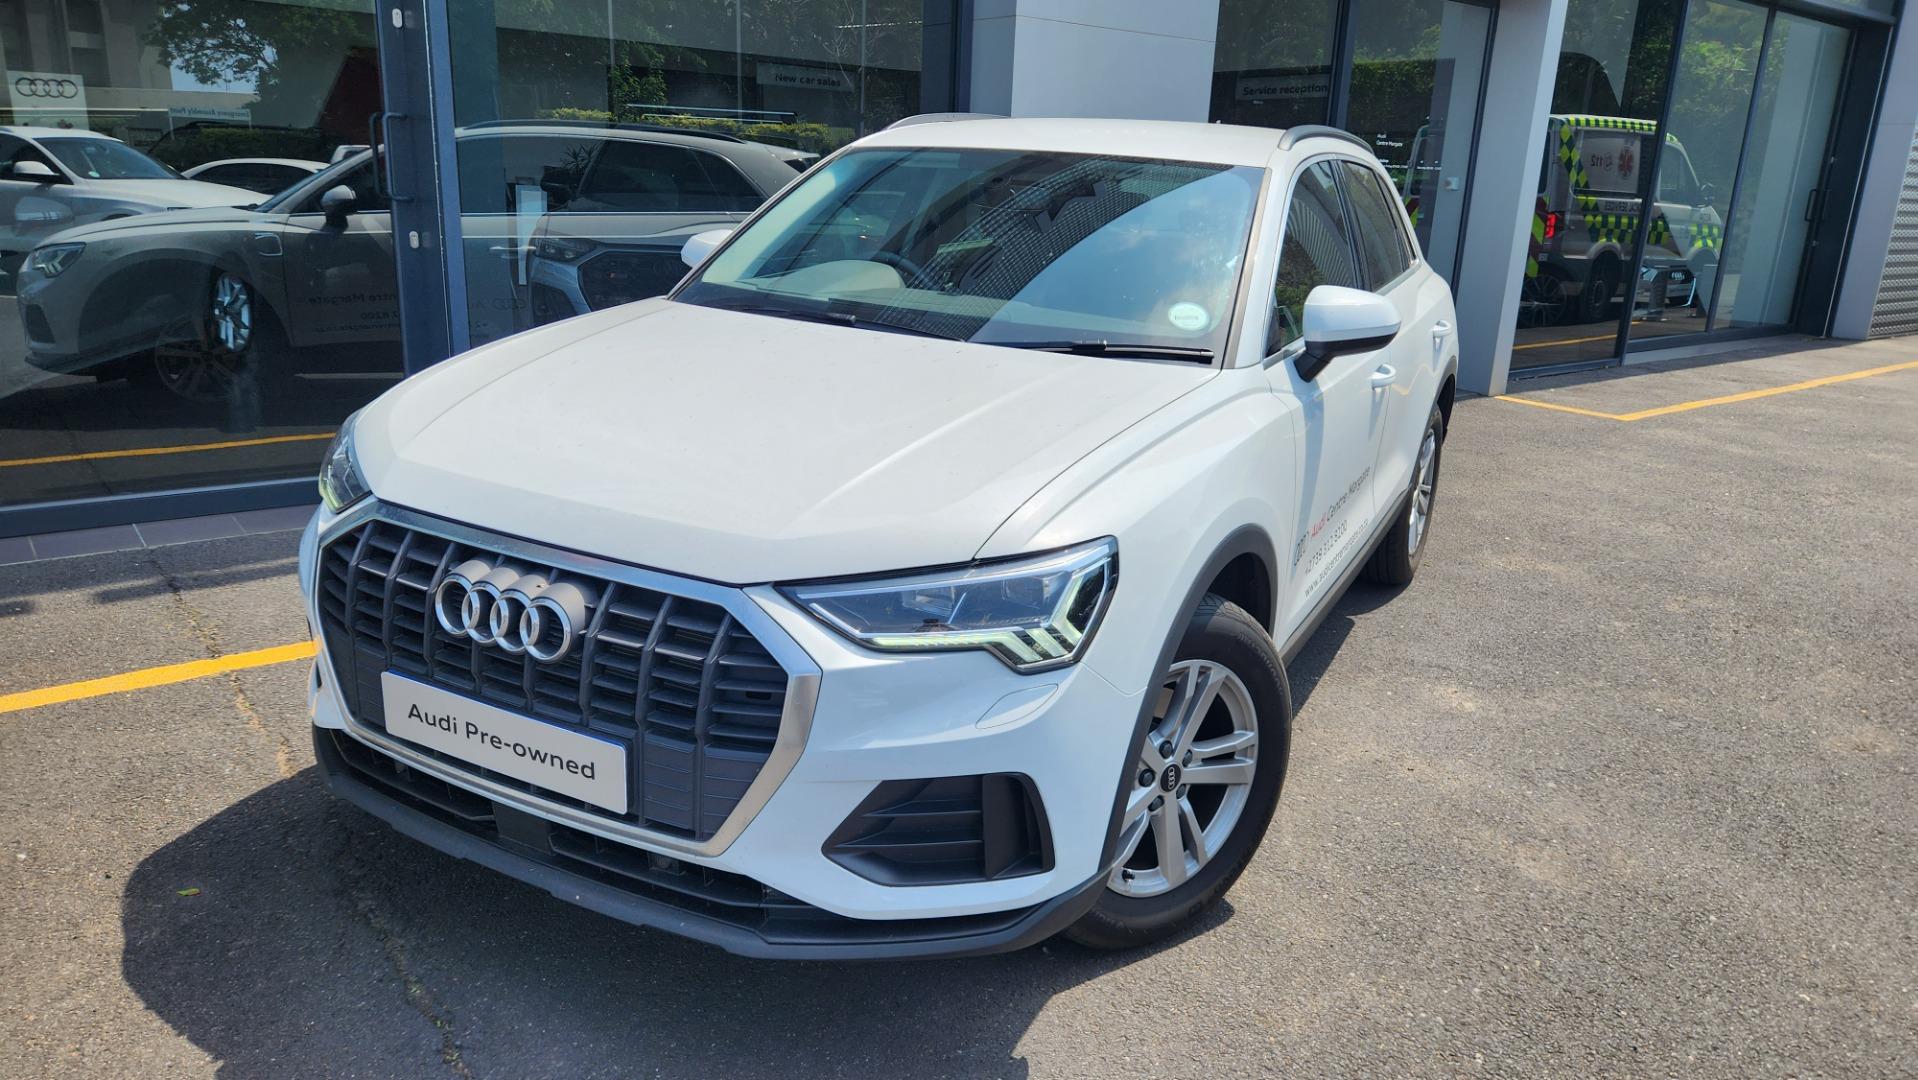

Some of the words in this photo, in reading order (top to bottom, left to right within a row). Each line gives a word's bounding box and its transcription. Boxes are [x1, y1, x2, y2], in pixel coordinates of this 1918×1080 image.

[775, 73, 797, 83] New
[799, 77, 815, 85] car
[816, 77, 841, 87] sales
[1241, 86, 1278, 96] Service
[1280, 83, 1327, 95] reception
[408, 703, 457, 734] Audi
[465, 721, 595, 780] Pre-owned
